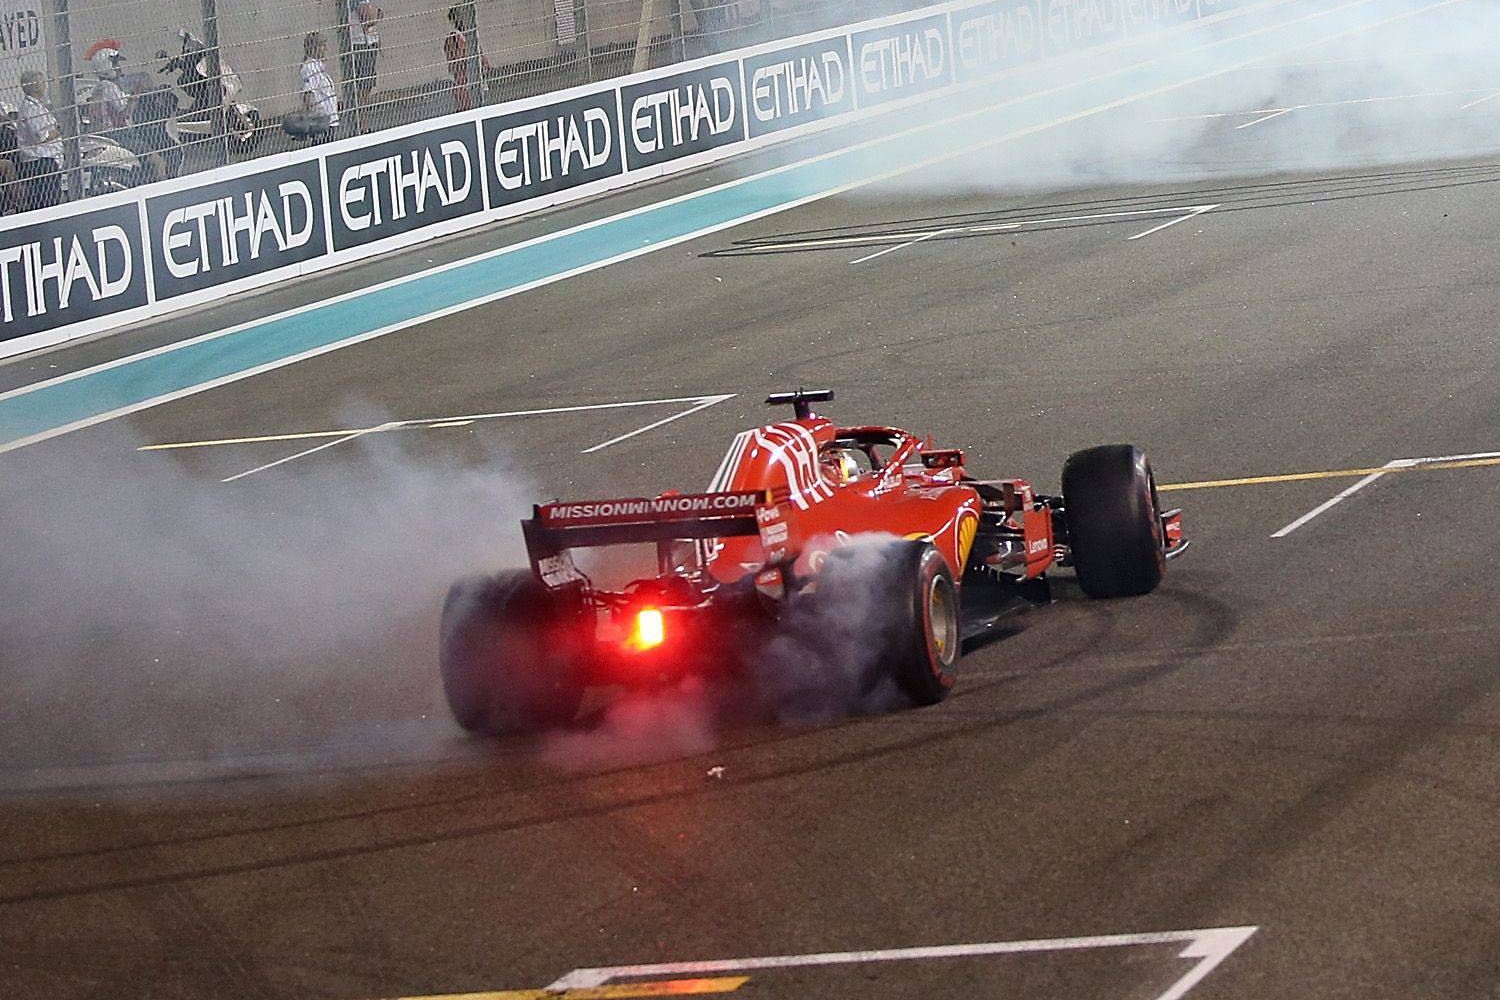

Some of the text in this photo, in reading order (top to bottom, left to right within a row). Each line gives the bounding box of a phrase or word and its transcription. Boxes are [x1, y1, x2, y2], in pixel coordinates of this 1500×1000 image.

[860, 28, 945, 94] ETIHAD
[959, 5, 1034, 67] ETIHAD
[631, 76, 736, 154] ETIHAD
[751, 50, 846, 122] ETIHAD
[338, 140, 474, 233] ETIHAD
[494, 107, 613, 190] ETIHAD
[162, 179, 315, 279] ETIHAD
[0, 224, 134, 323] TIHAD
[550, 493, 756, 520] MISSIONWINNOW.COM
